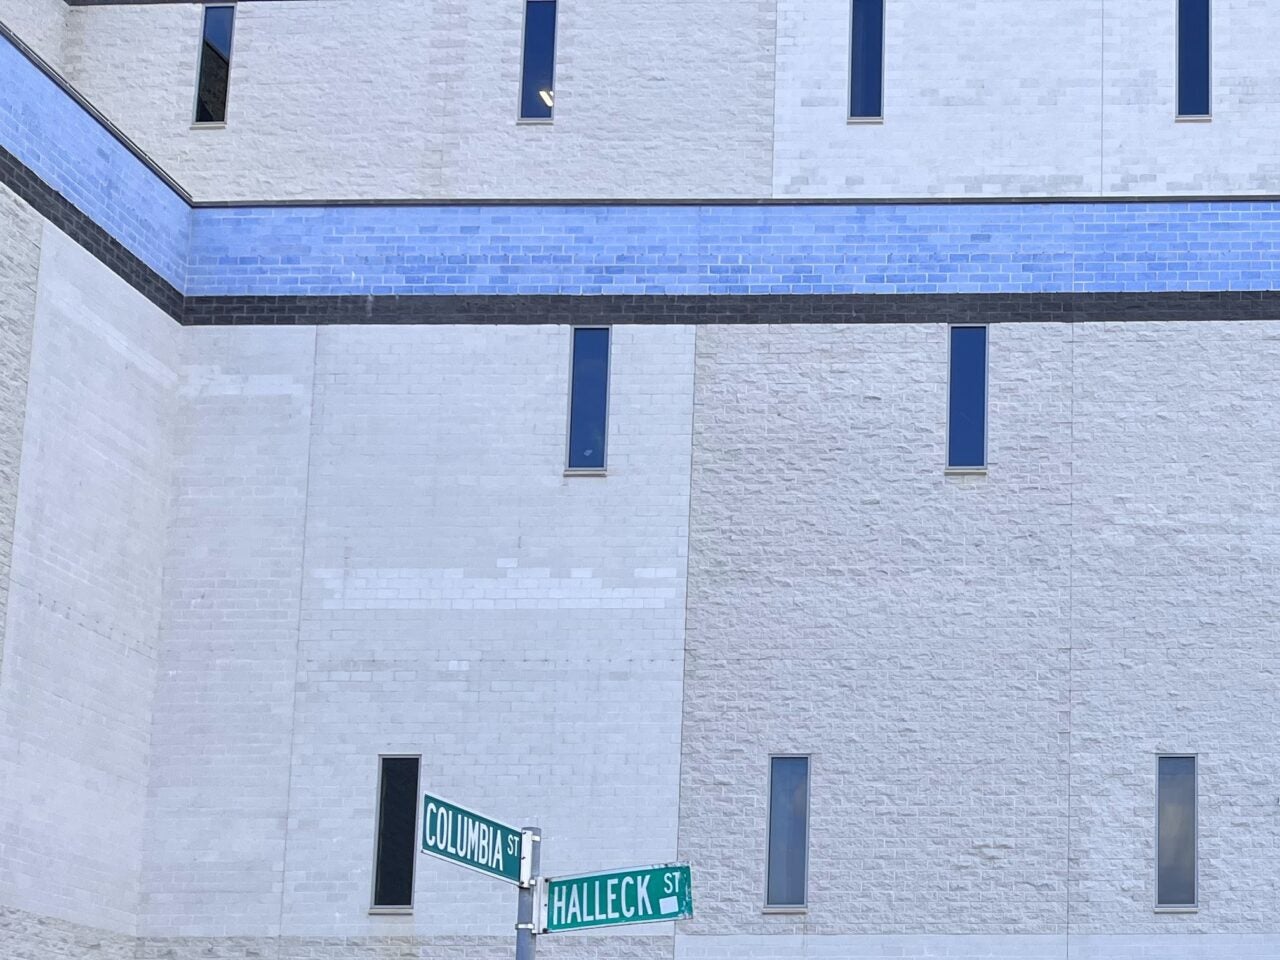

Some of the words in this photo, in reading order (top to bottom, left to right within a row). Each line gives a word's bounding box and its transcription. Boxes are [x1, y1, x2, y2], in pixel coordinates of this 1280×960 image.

[425, 802, 504, 872] COLUMBIA
[507, 833, 520, 857] ST
[552, 874, 654, 925] HALLECK
[663, 871, 681, 894] ST
